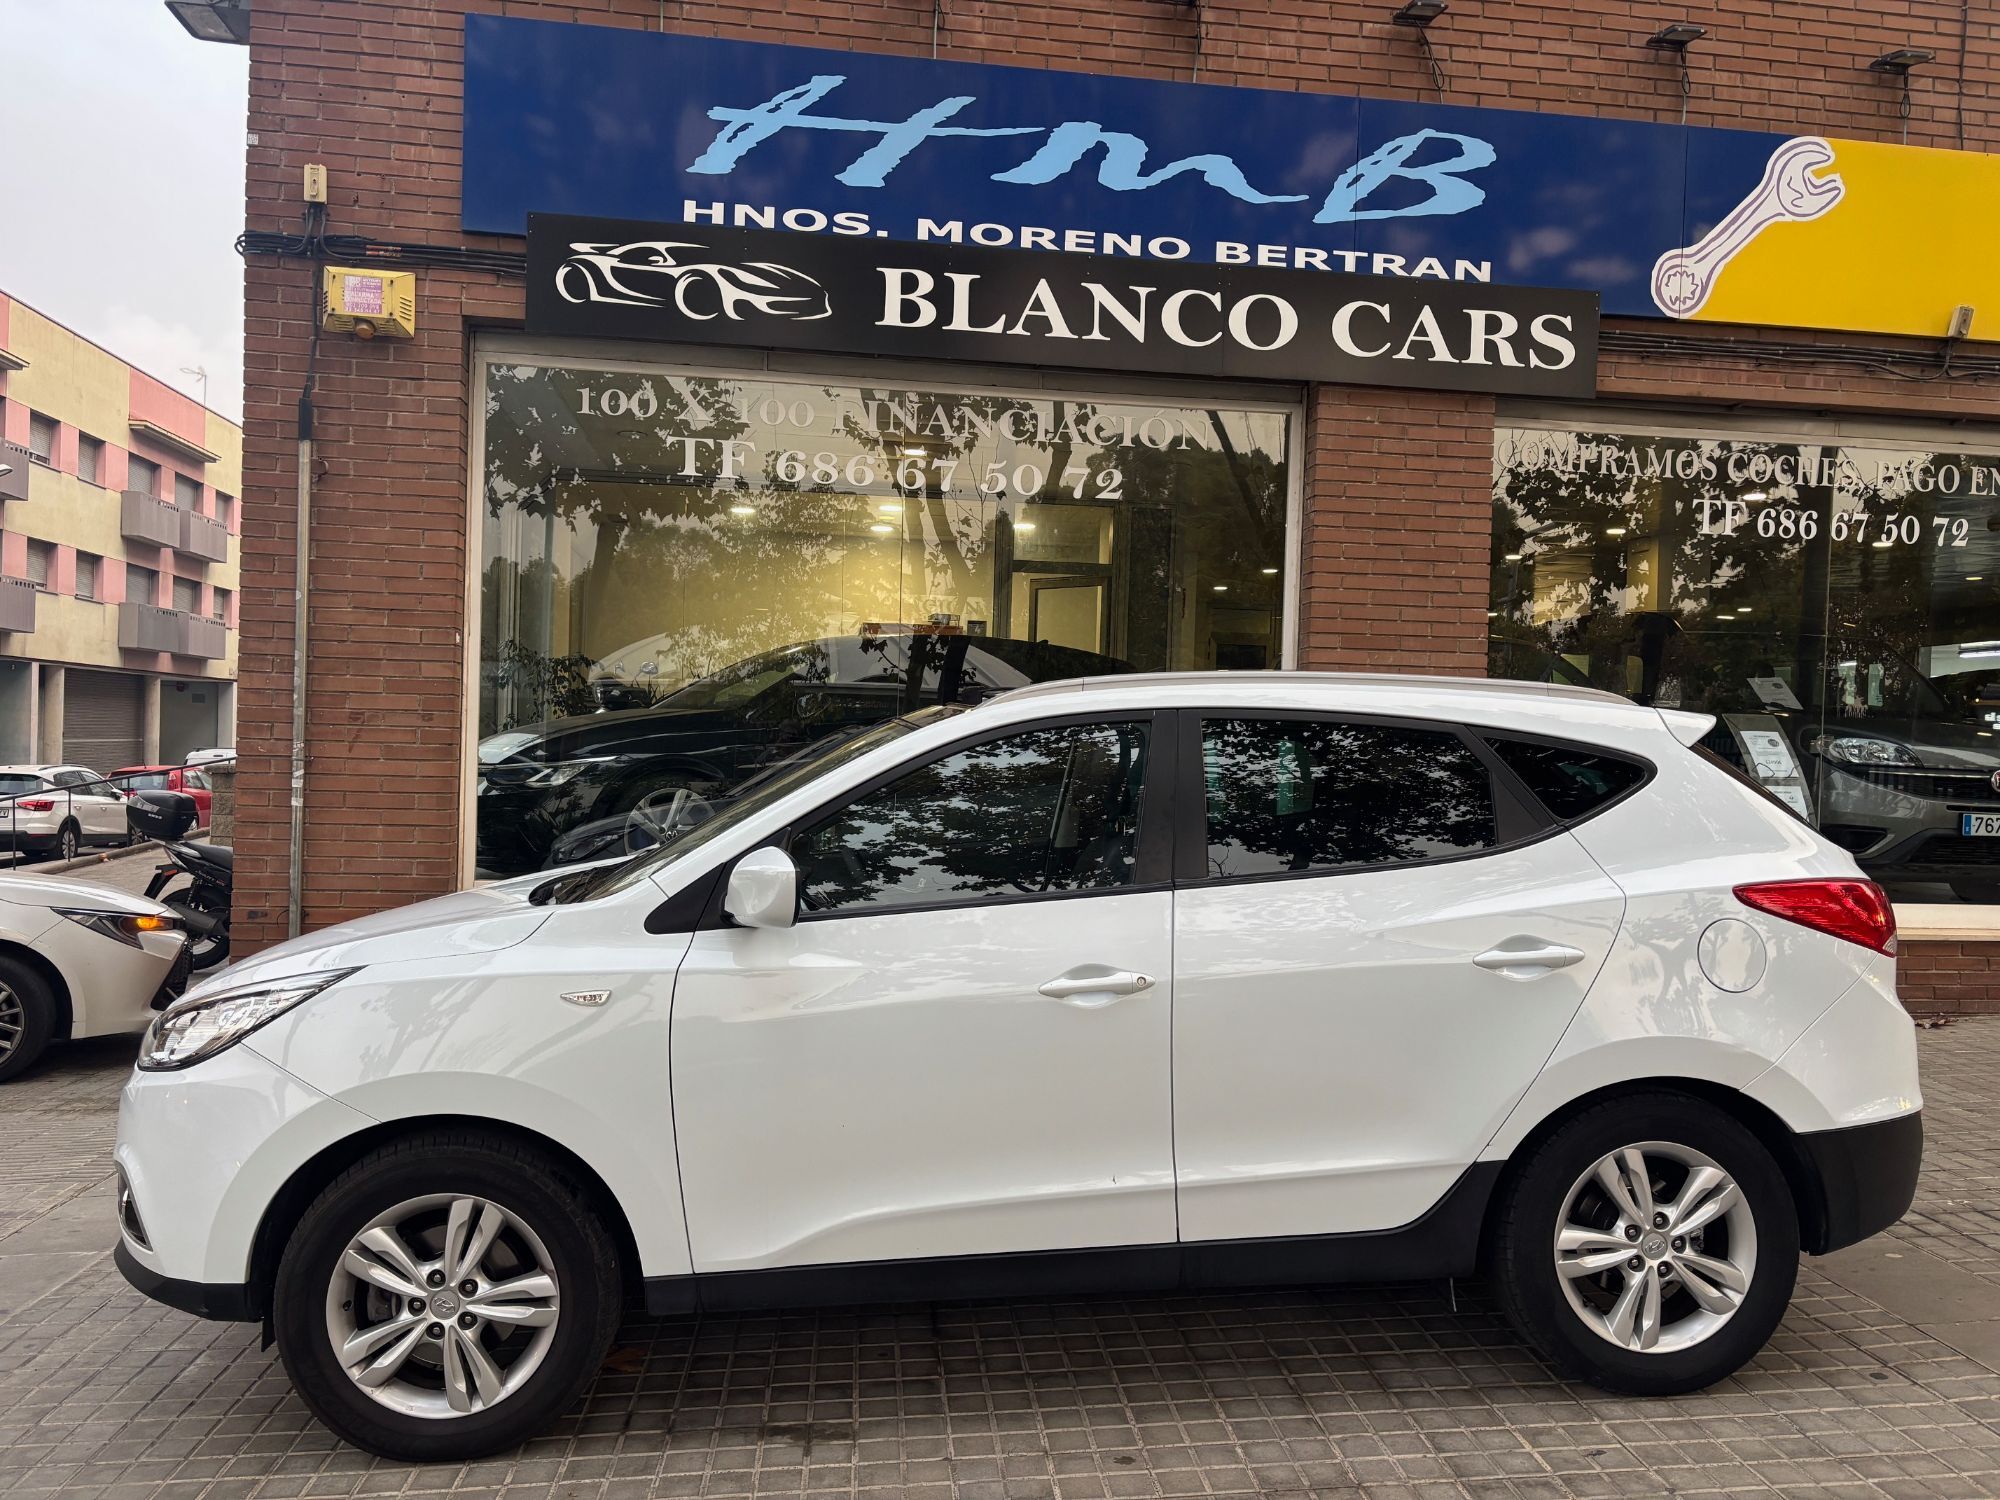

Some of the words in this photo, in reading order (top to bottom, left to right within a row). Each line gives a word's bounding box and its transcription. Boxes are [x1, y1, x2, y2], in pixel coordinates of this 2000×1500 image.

[683, 200, 888, 238] HNOS.
[917, 218, 1191, 260] MORENO
[1216, 241, 1491, 282] BERTRAN
[875, 267, 1298, 350] BLANCO
[1332, 300, 1576, 370] CARS
[576, 386, 658, 418] 100
[675, 386, 717, 422] X
[735, 397, 815, 428] 100
[832, 398, 1213, 451] FINANCIACIÓN
[666, 436, 755, 479] TF
[776, 450, 875, 486] 686
[896, 457, 960, 493] 67
[980, 460, 1043, 496] 50
[1064, 466, 1123, 500] 72
[1497, 438, 1718, 481] COMPRAMOS
[1875, 459, 1960, 495] PAGO
[1692, 498, 1746, 536] TF
[1757, 508, 1819, 540] 686
[1831, 511, 1869, 544] 67
[1881, 512, 1921, 545] 50
[1932, 516, 1970, 548] 72
